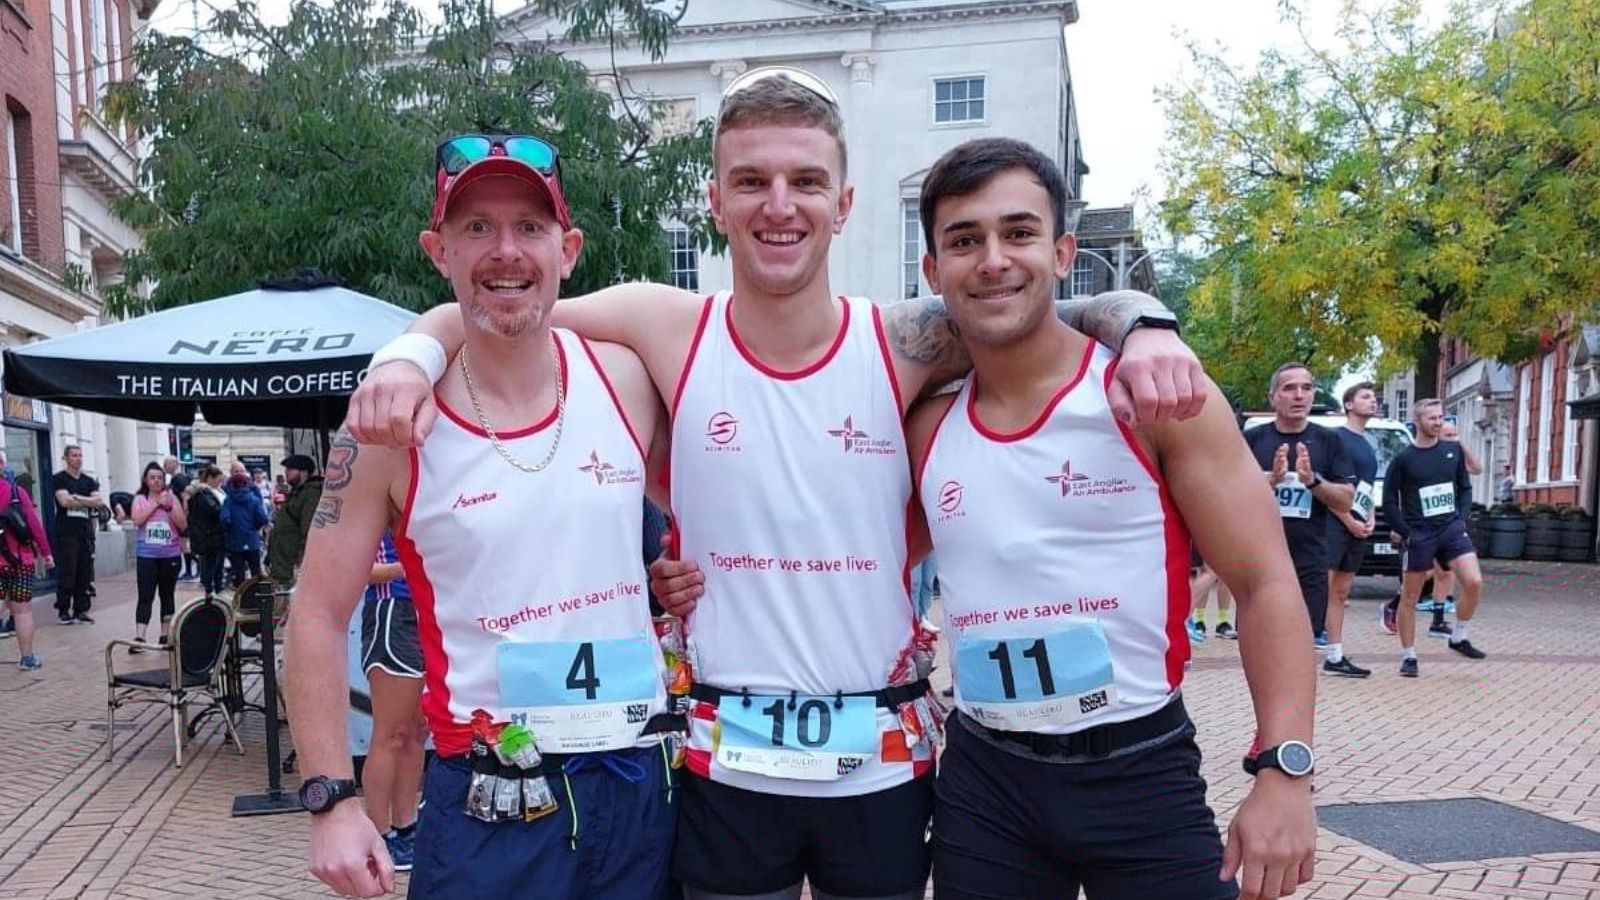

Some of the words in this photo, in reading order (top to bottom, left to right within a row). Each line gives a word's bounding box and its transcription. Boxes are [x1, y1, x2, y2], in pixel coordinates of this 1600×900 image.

[168, 333, 356, 356] NERO
[117, 375, 162, 395] THE
[172, 377, 258, 396] ITALIAN
[267, 370, 353, 394] COFFEE
[709, 553, 774, 572] Together
[779, 558, 802, 571] we
[807, 559, 841, 572] save
[477, 606, 554, 632] Together
[558, 597, 582, 613] we
[585, 588, 615, 606] save
[1003, 607, 1029, 621] we
[1034, 603, 1073, 617] save
[1078, 597, 1119, 613] lives
[566, 642, 600, 700] 4
[988, 638, 1056, 699] 11
[762, 699, 831, 748] 10
